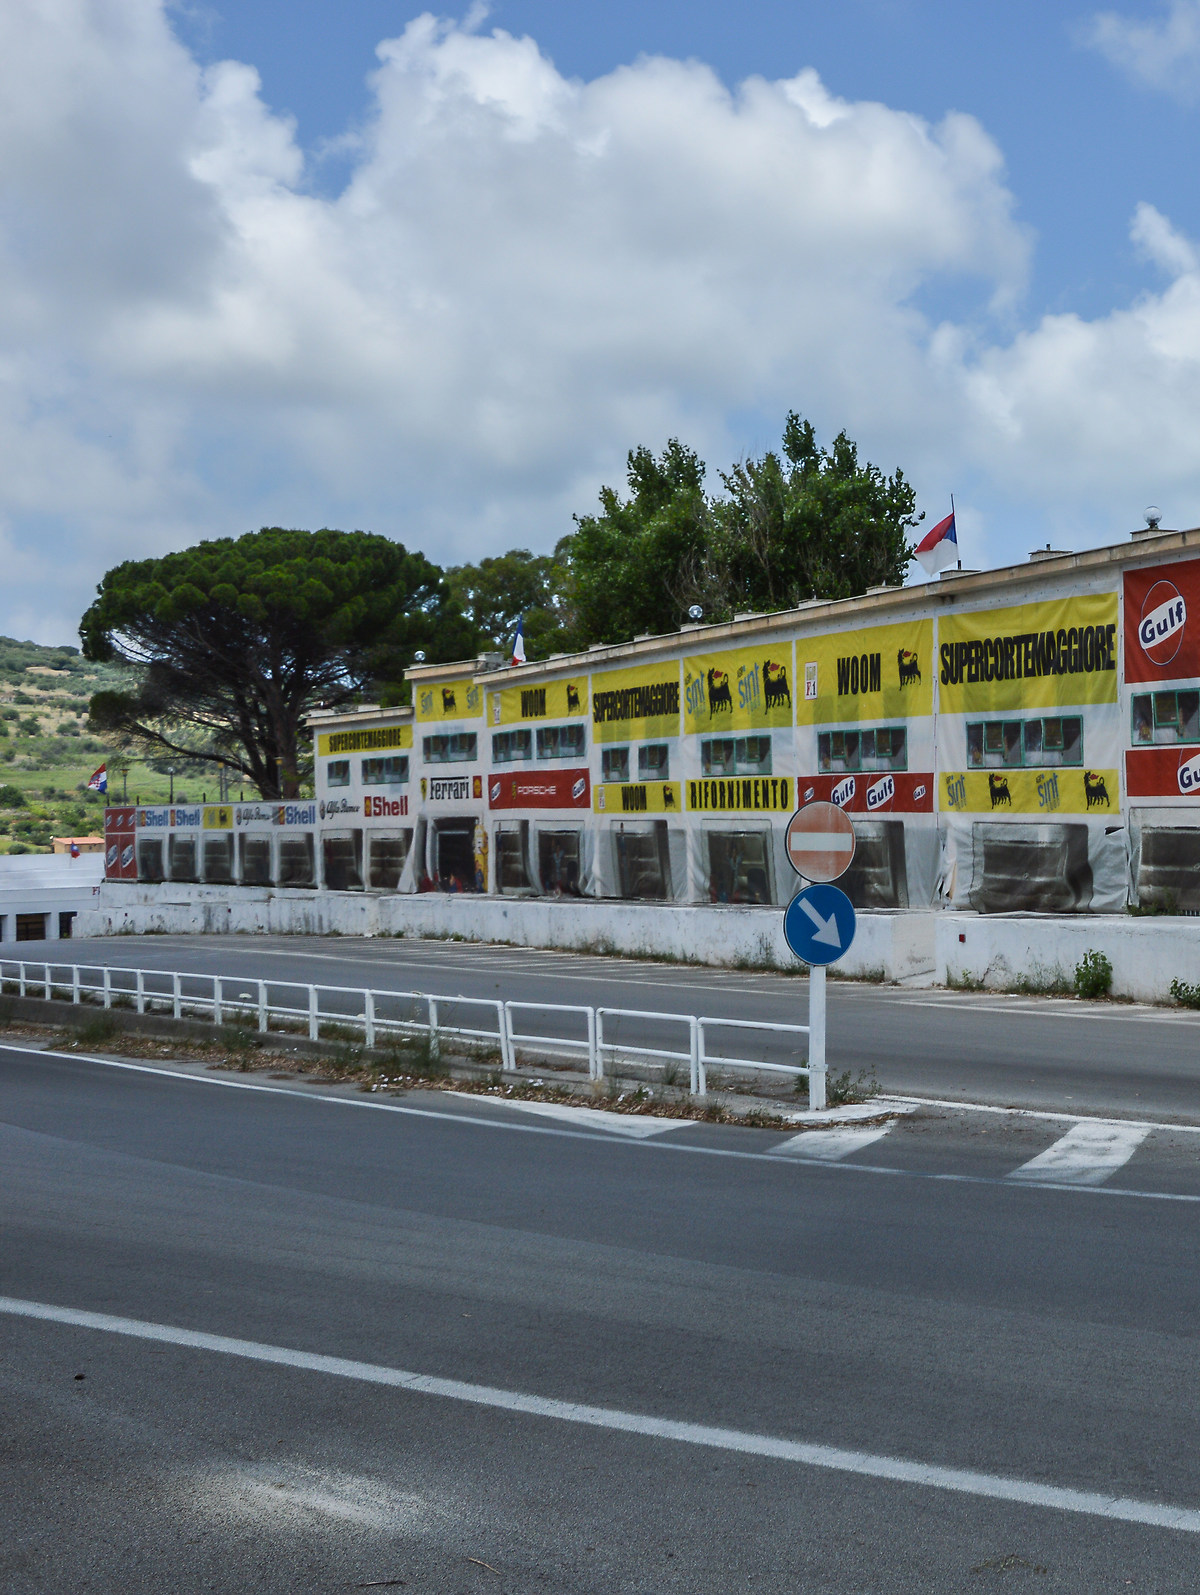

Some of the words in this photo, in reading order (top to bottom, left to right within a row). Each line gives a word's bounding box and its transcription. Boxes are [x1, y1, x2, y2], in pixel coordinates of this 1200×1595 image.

[1140, 600, 1186, 645] Gulf
[940, 623, 1116, 686] SUPERCORTEMAGGIORE
[837, 652, 882, 696] WOOM
[520, 688, 547, 718] WOOM
[592, 681, 680, 724] SUPERCORTEMAGGIORE
[328, 727, 402, 753] SUPERCORTEMAGGIORE
[430, 776, 470, 800] Ferrari
[517, 785, 557, 795] PORSCHE
[621, 785, 647, 811] WOOM
[690, 779, 789, 810] RIFORNIMENTO
[832, 779, 855, 806] Gulf
[867, 778, 893, 807] Gulf
[145, 810, 169, 827] Shell
[176, 808, 200, 826] Shell
[285, 805, 316, 825] Shell
[372, 794, 409, 817] Shell
